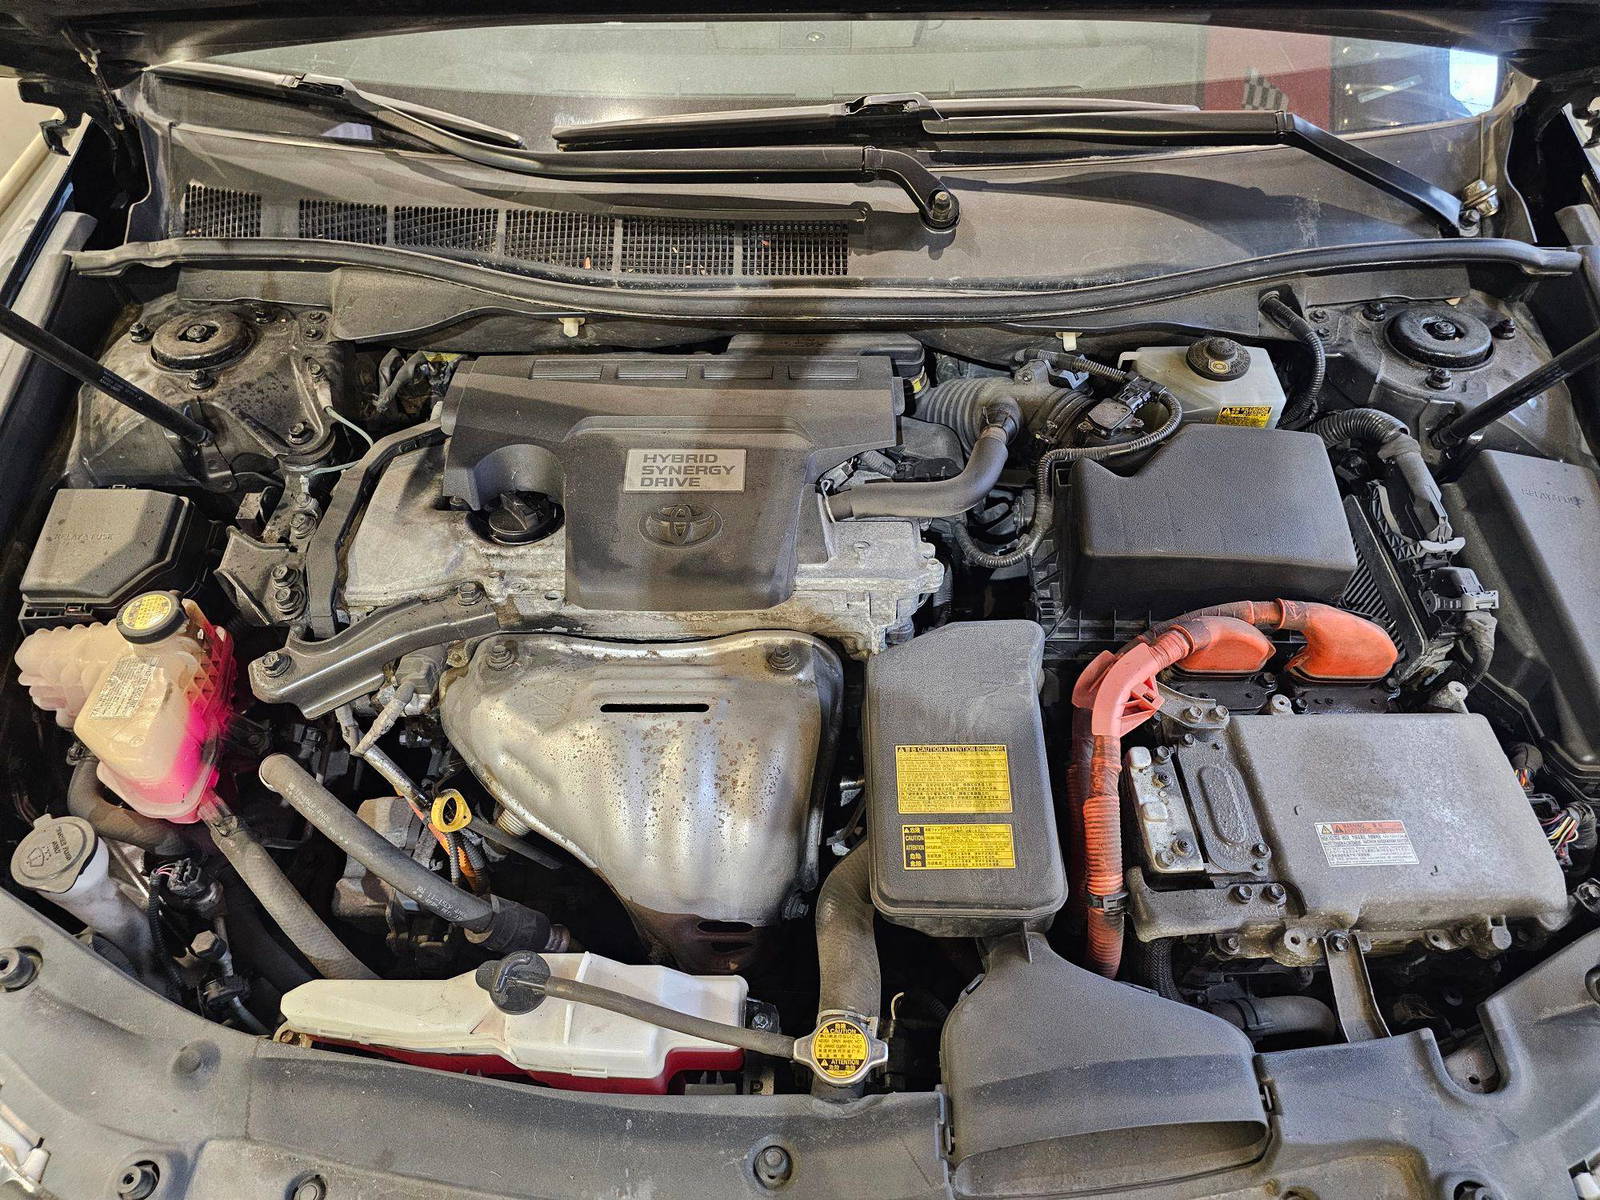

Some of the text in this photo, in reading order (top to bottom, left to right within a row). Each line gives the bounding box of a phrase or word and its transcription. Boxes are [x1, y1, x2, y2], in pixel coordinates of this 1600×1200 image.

[643, 454, 718, 463] HYBRID
[641, 465, 736, 475] SYNERGY
[640, 477, 701, 487] DRIVE
